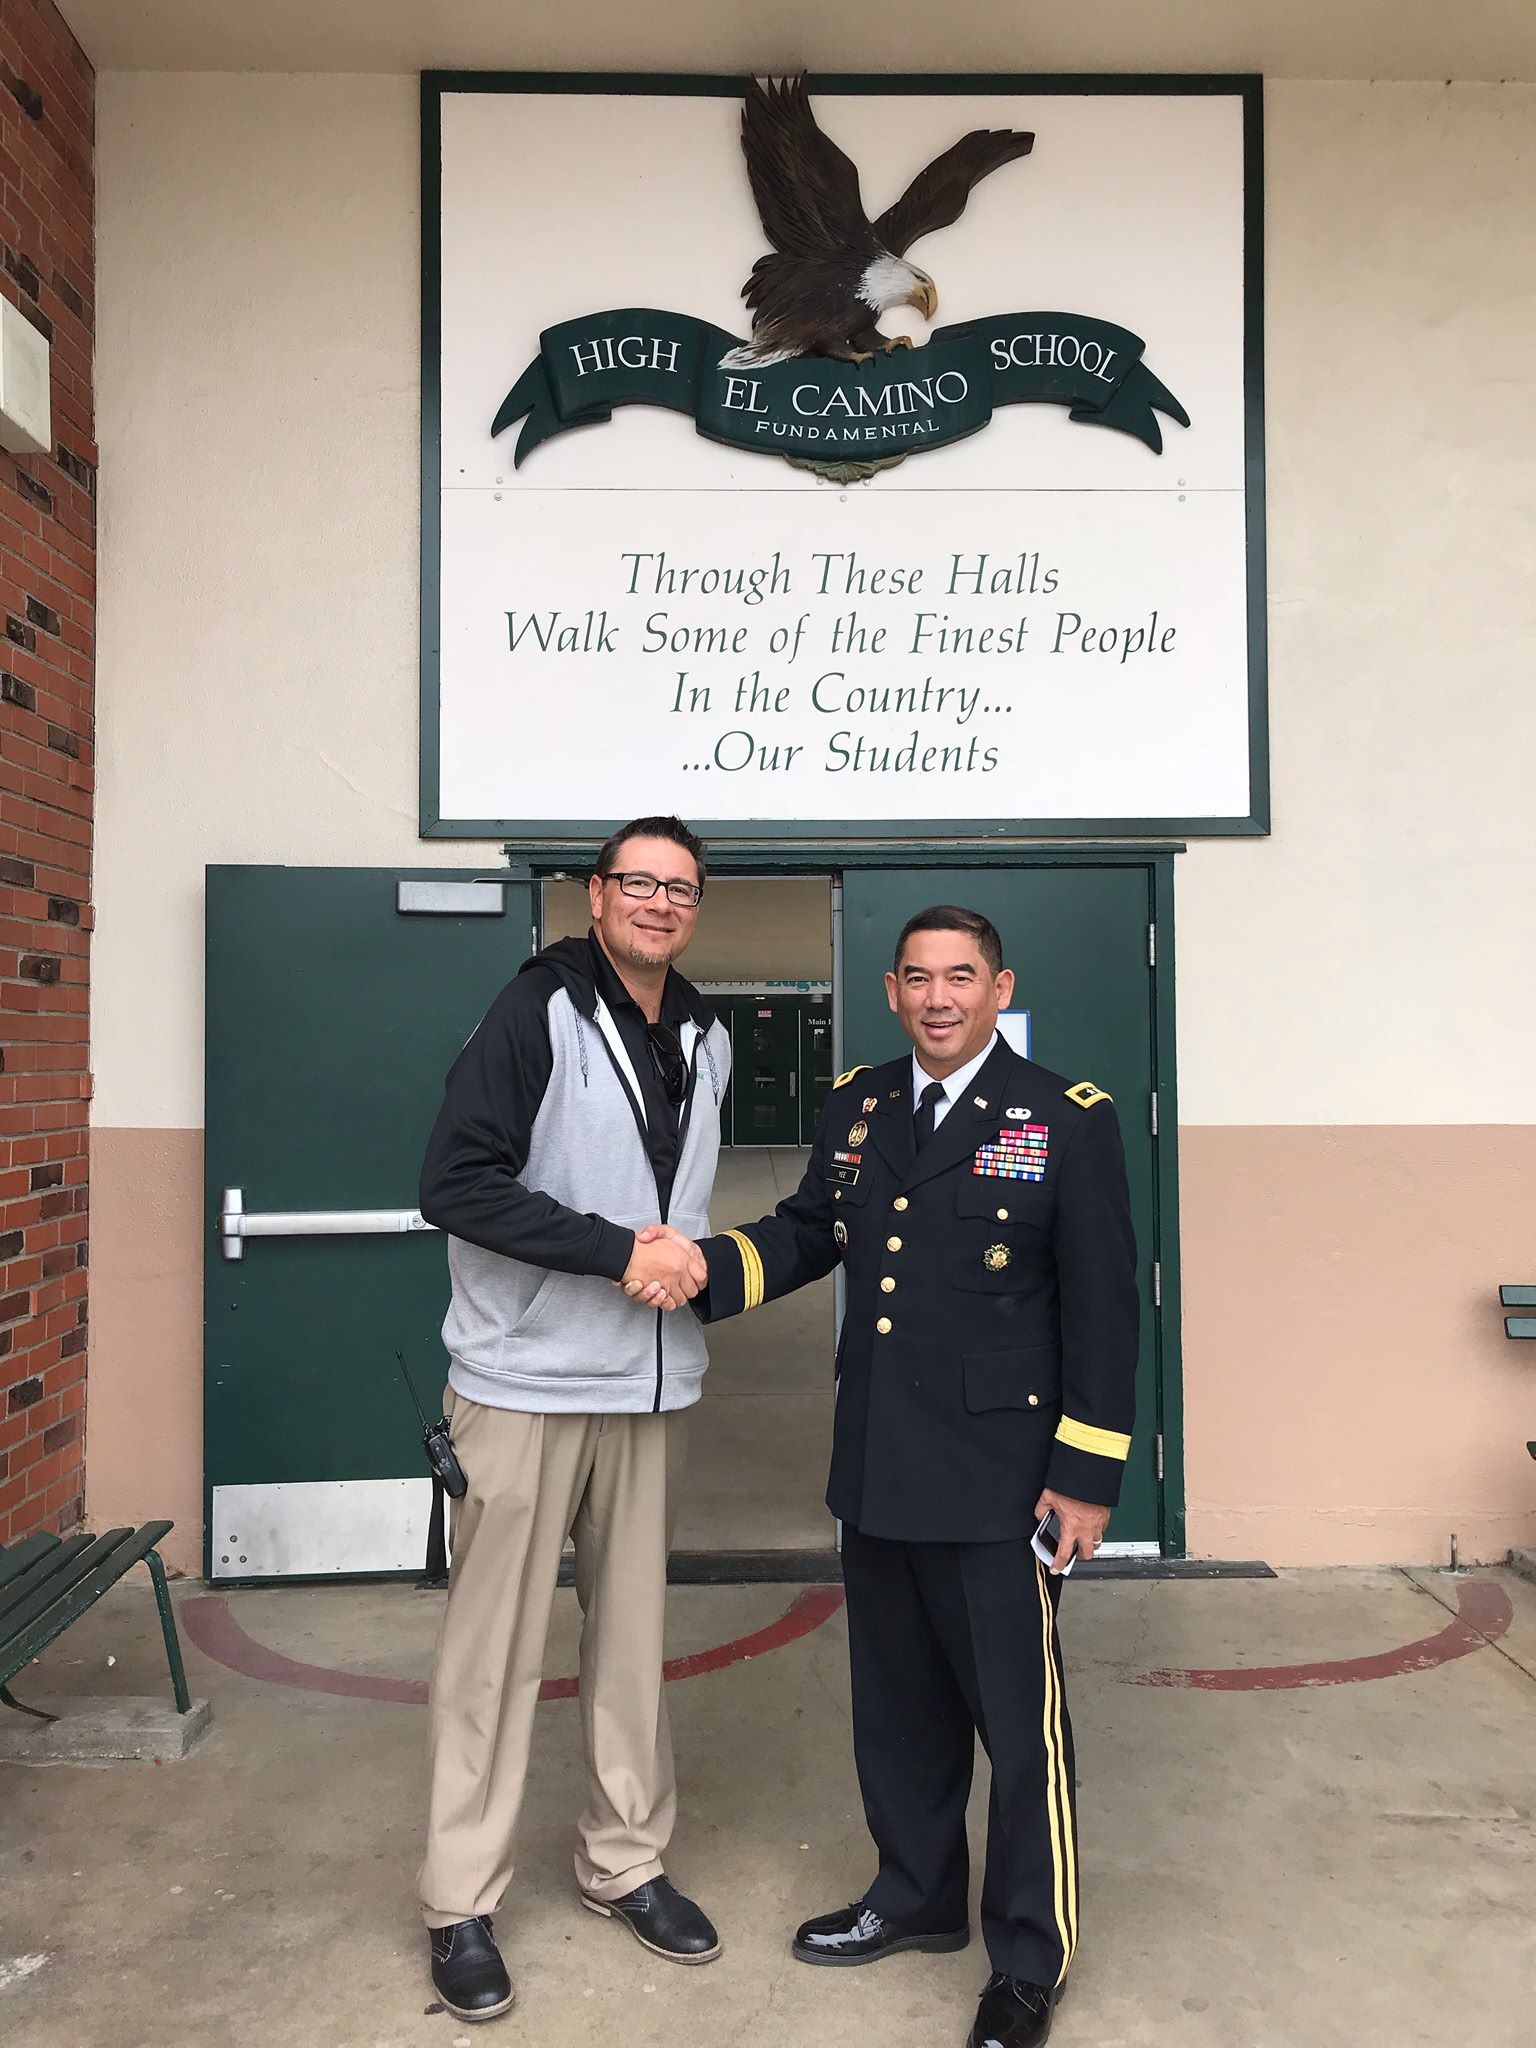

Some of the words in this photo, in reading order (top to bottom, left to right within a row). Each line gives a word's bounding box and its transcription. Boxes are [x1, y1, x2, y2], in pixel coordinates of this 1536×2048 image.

[568, 336, 682, 377] HIGH
[990, 334, 1119, 383] SCHOOL
[721, 376, 769, 414] EL
[792, 371, 968, 417] CAMINO
[755, 419, 940, 441] FUNDAMENTAL
[620, 551, 792, 606] Through
[811, 551, 924, 595] These
[944, 552, 1059, 595] Halls
[503, 610, 620, 653] Walk
[642, 612, 748, 654] Some
[769, 613, 811, 664] of
[831, 610, 887, 654] the
[908, 612, 1029, 654] Finest
[1049, 610, 1177, 664] People
[669, 671, 712, 713] In
[734, 670, 790, 713] the
[811, 671, 1012, 725] Country...
[682, 730, 804, 772] ...Our
[824, 729, 999, 773] Students
[808, 1018, 826, 1026] Main
